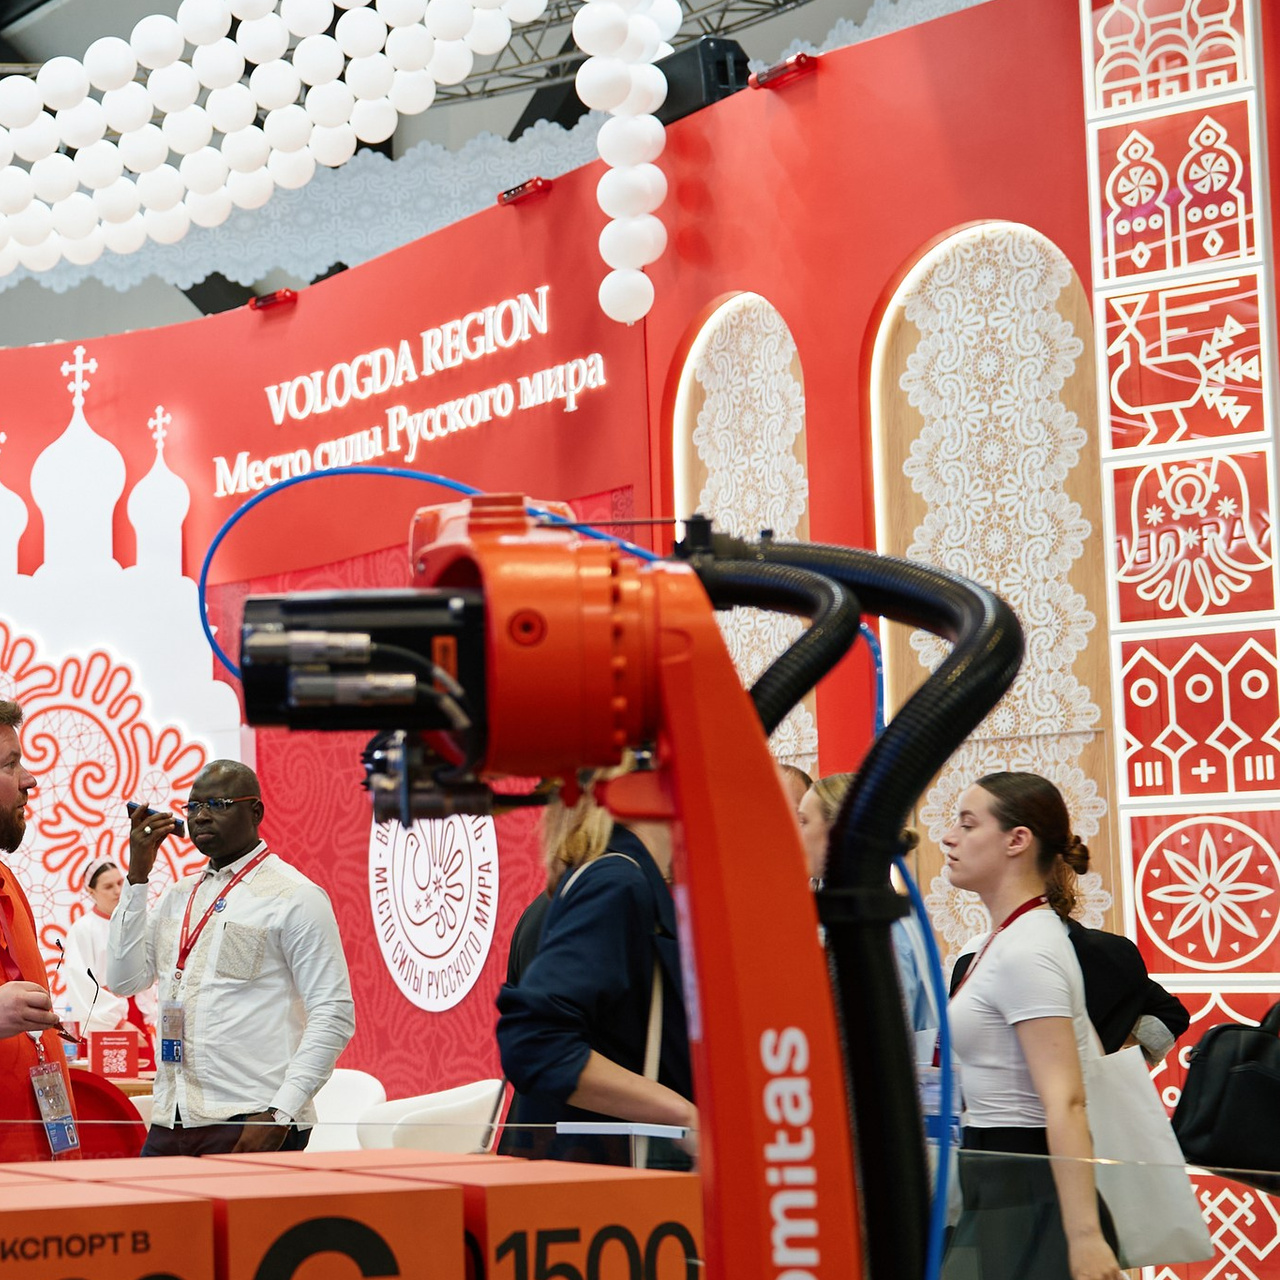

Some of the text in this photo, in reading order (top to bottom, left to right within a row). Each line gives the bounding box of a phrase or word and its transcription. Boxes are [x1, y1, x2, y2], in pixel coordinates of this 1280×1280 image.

[213, 352, 607, 498] Место силы Русского мира
[266, 285, 550, 425] VOLOGDA REGION
[375, 860, 493, 1000] МЕСТО СИЛЫ РУССКОГО МИРА
[130, 1231, 151, 1254] В
